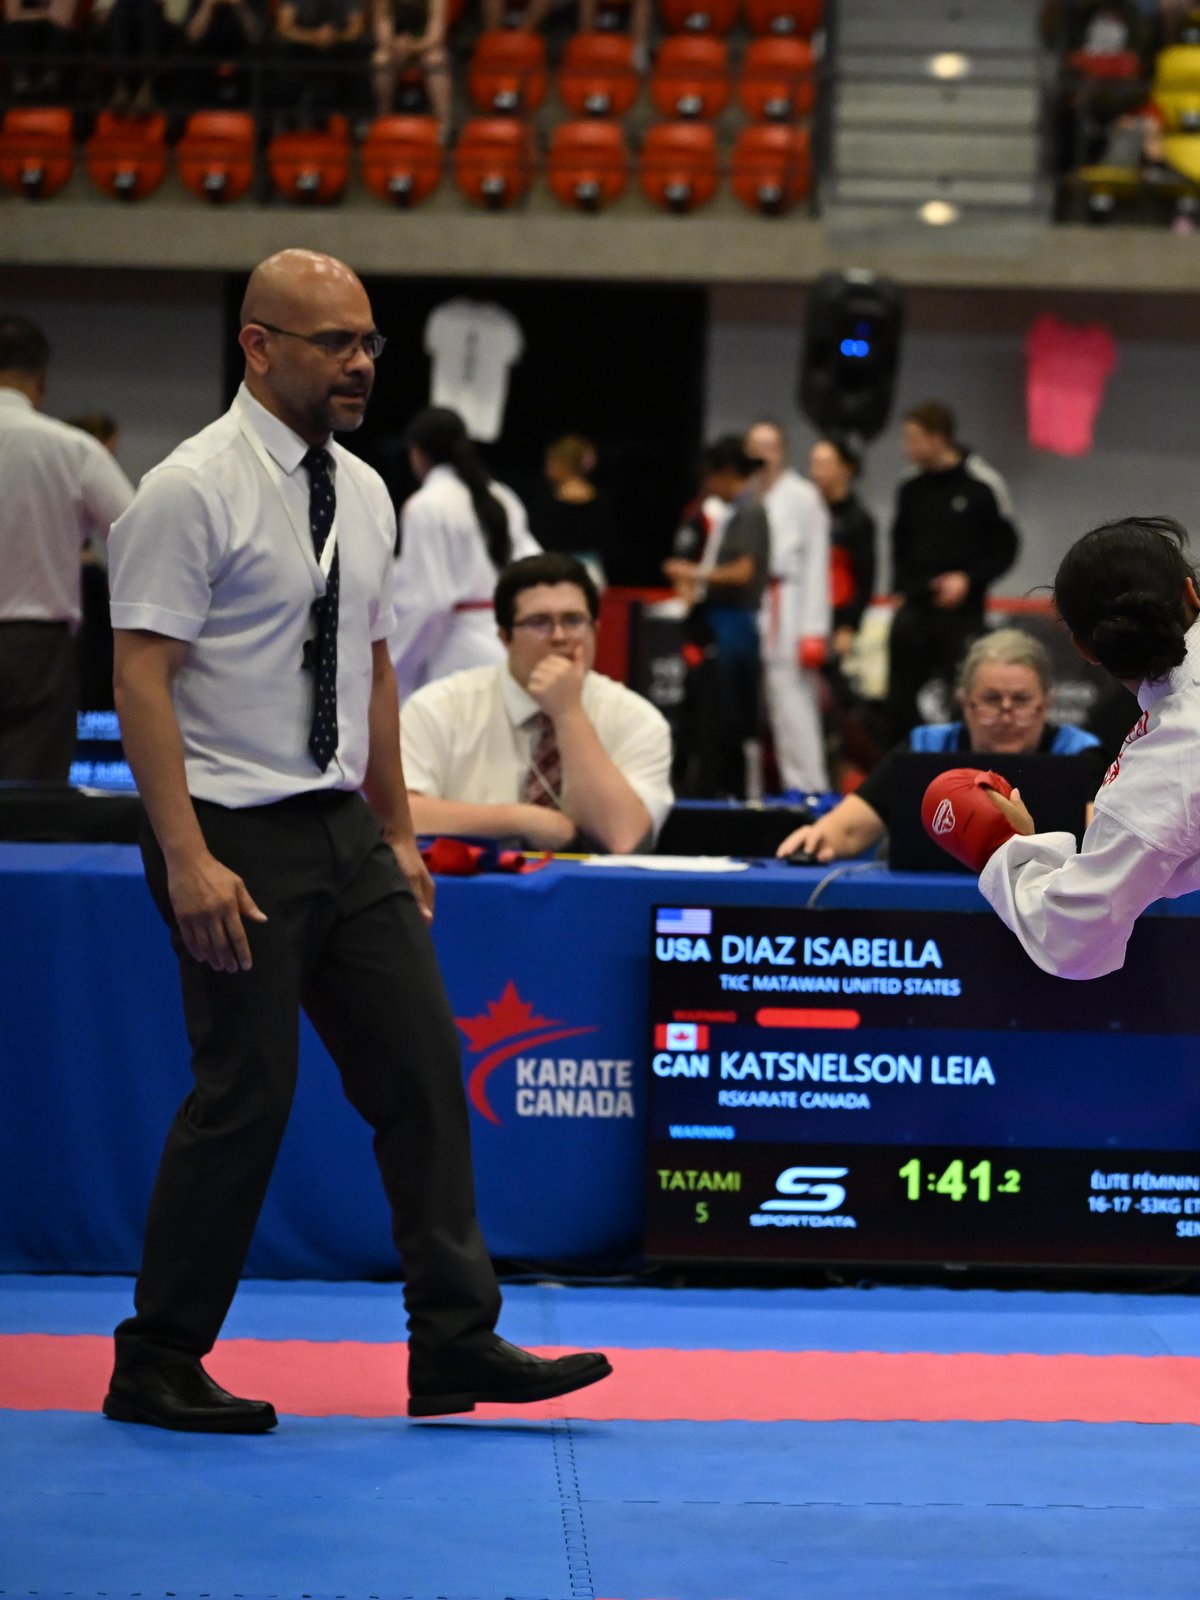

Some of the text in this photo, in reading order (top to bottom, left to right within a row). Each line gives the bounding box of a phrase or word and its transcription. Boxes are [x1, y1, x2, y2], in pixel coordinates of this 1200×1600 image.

[655, 935, 943, 969] USA DIAZ ISABELLA
[718, 973, 962, 997] TKC MATAWAN UNITED STATES
[515, 1057, 634, 1088] KARATE
[652, 1051, 996, 1086] CAN KATSNELSON LEIA
[515, 1089, 635, 1119] CANADA
[800, 1091, 871, 1110] CANADA
[669, 1124, 736, 1140] WARNING
[657, 1169, 742, 1192] TATAMI
[1090, 1169, 1130, 1190] ÉLITE
[1132, 1170, 1200, 1191] FÉMININ
[694, 1201, 709, 1224] 5
[1088, 1195, 1132, 1213] 16-17
[749, 1213, 857, 1229] SPORTDATA
